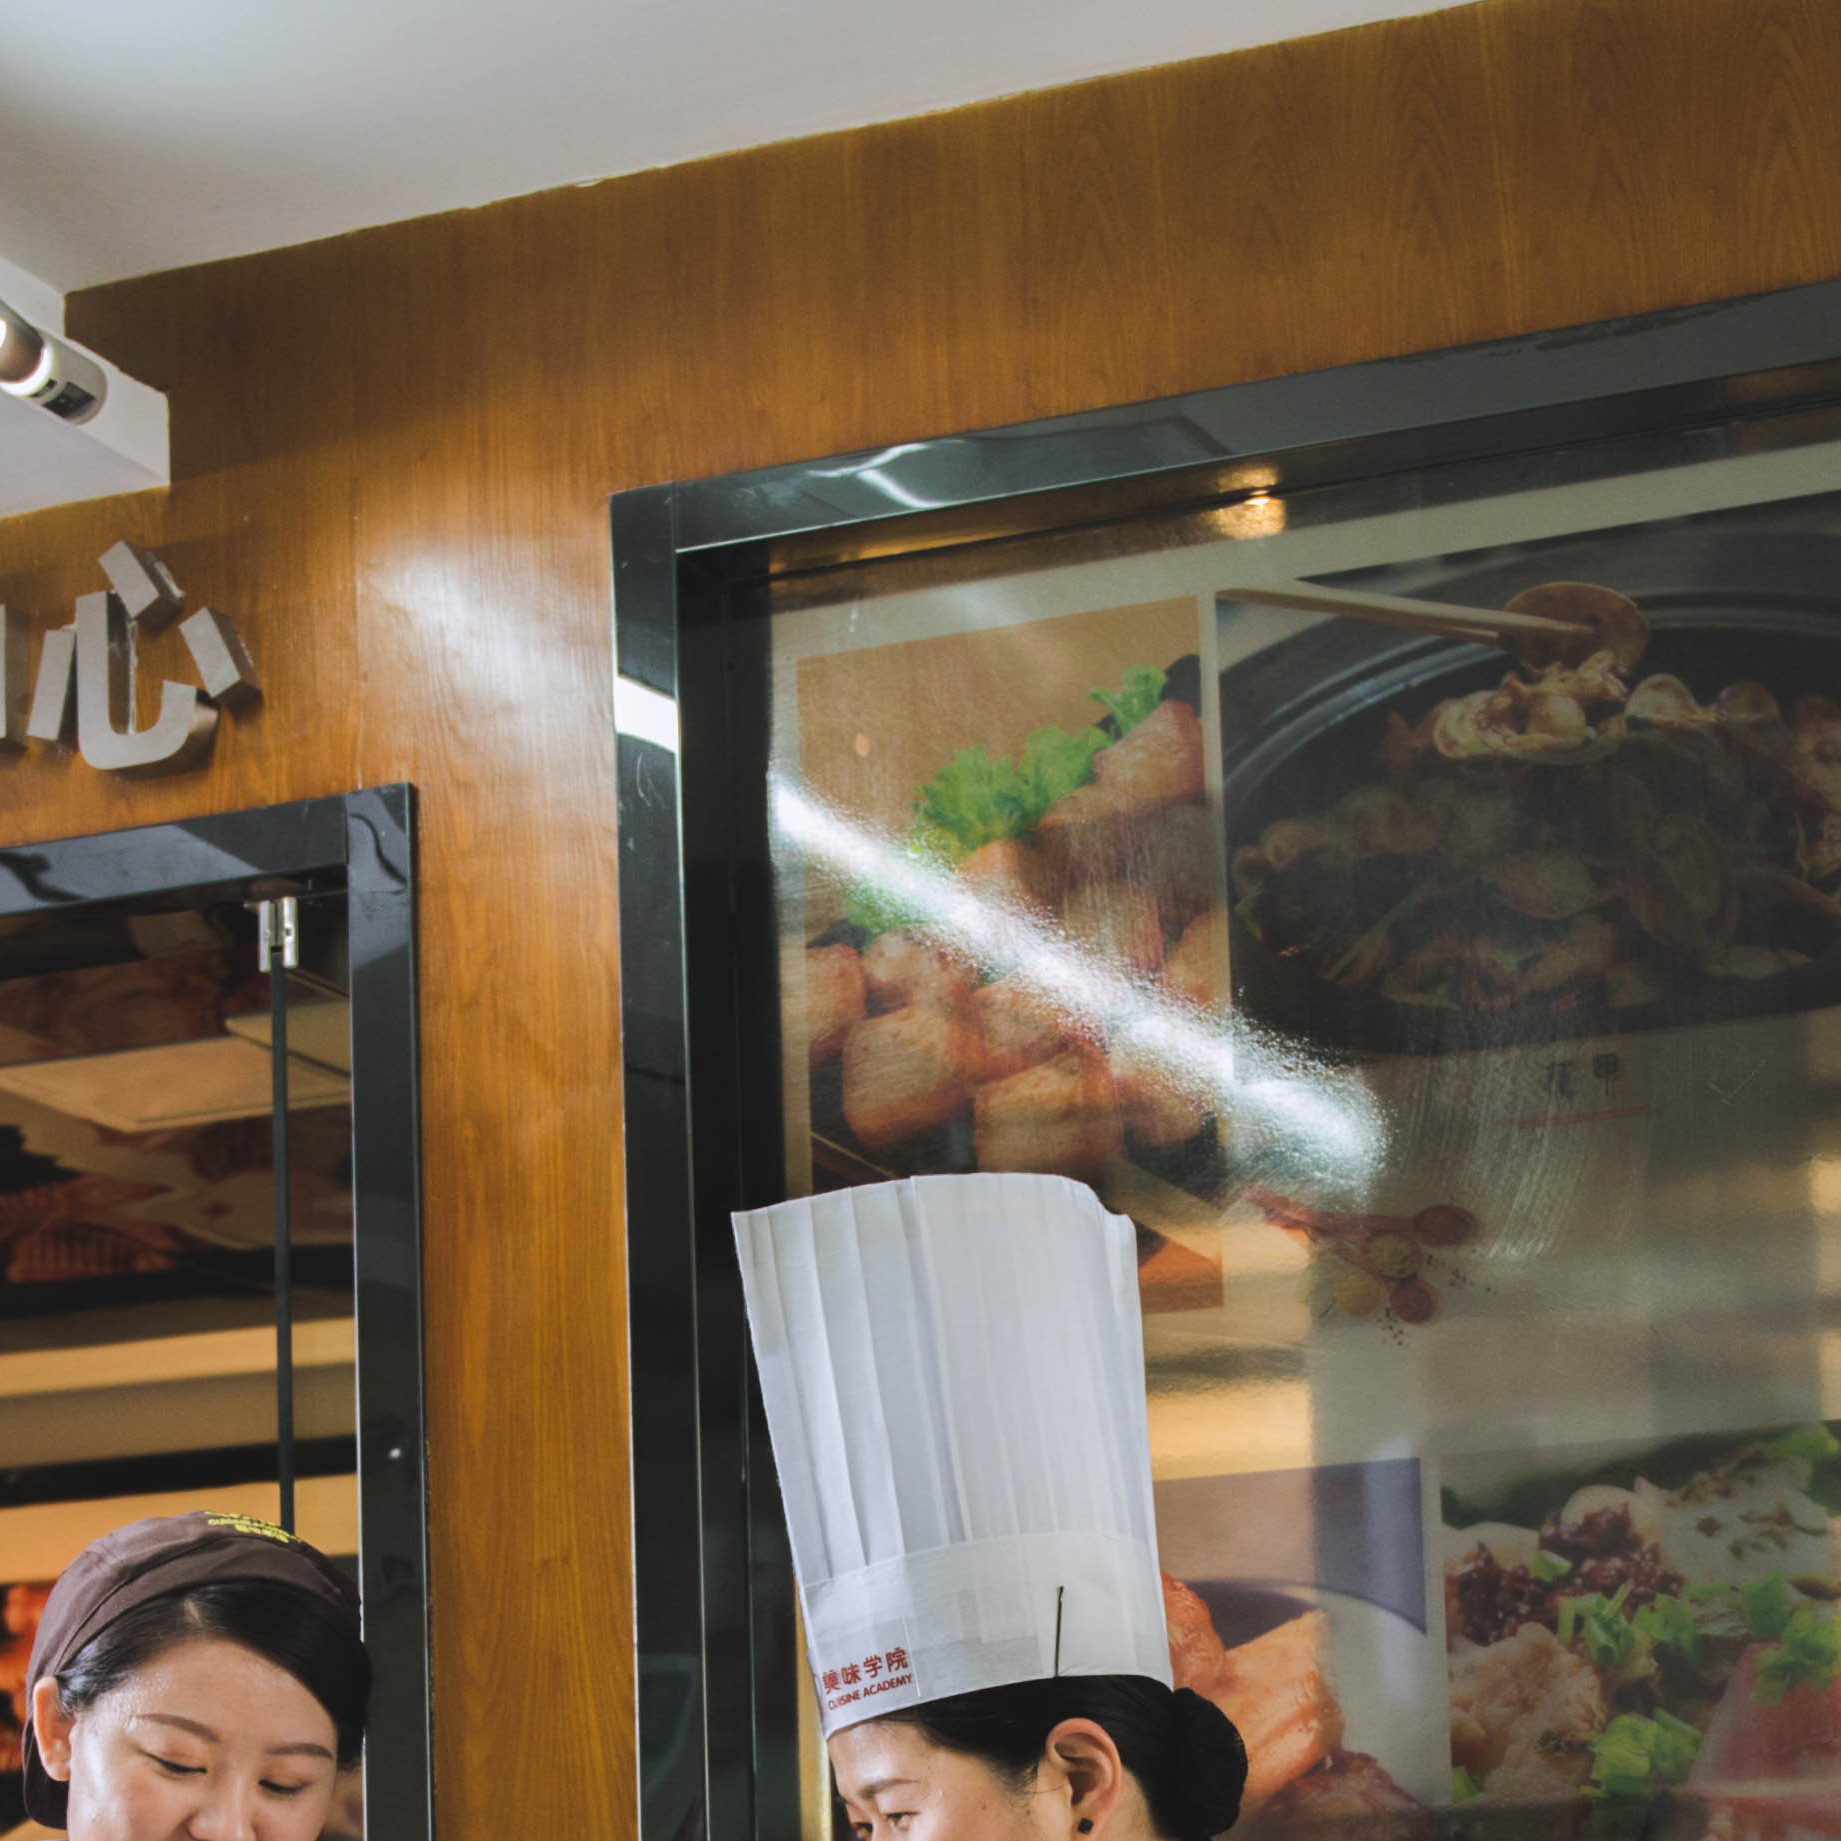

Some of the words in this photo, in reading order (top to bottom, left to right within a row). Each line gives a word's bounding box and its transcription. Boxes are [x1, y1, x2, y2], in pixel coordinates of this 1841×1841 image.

[822, 1646, 909, 1696] 美味学院
[827, 1689, 862, 1711] CUISINE
[863, 1673, 913, 1698] ACADEMY
